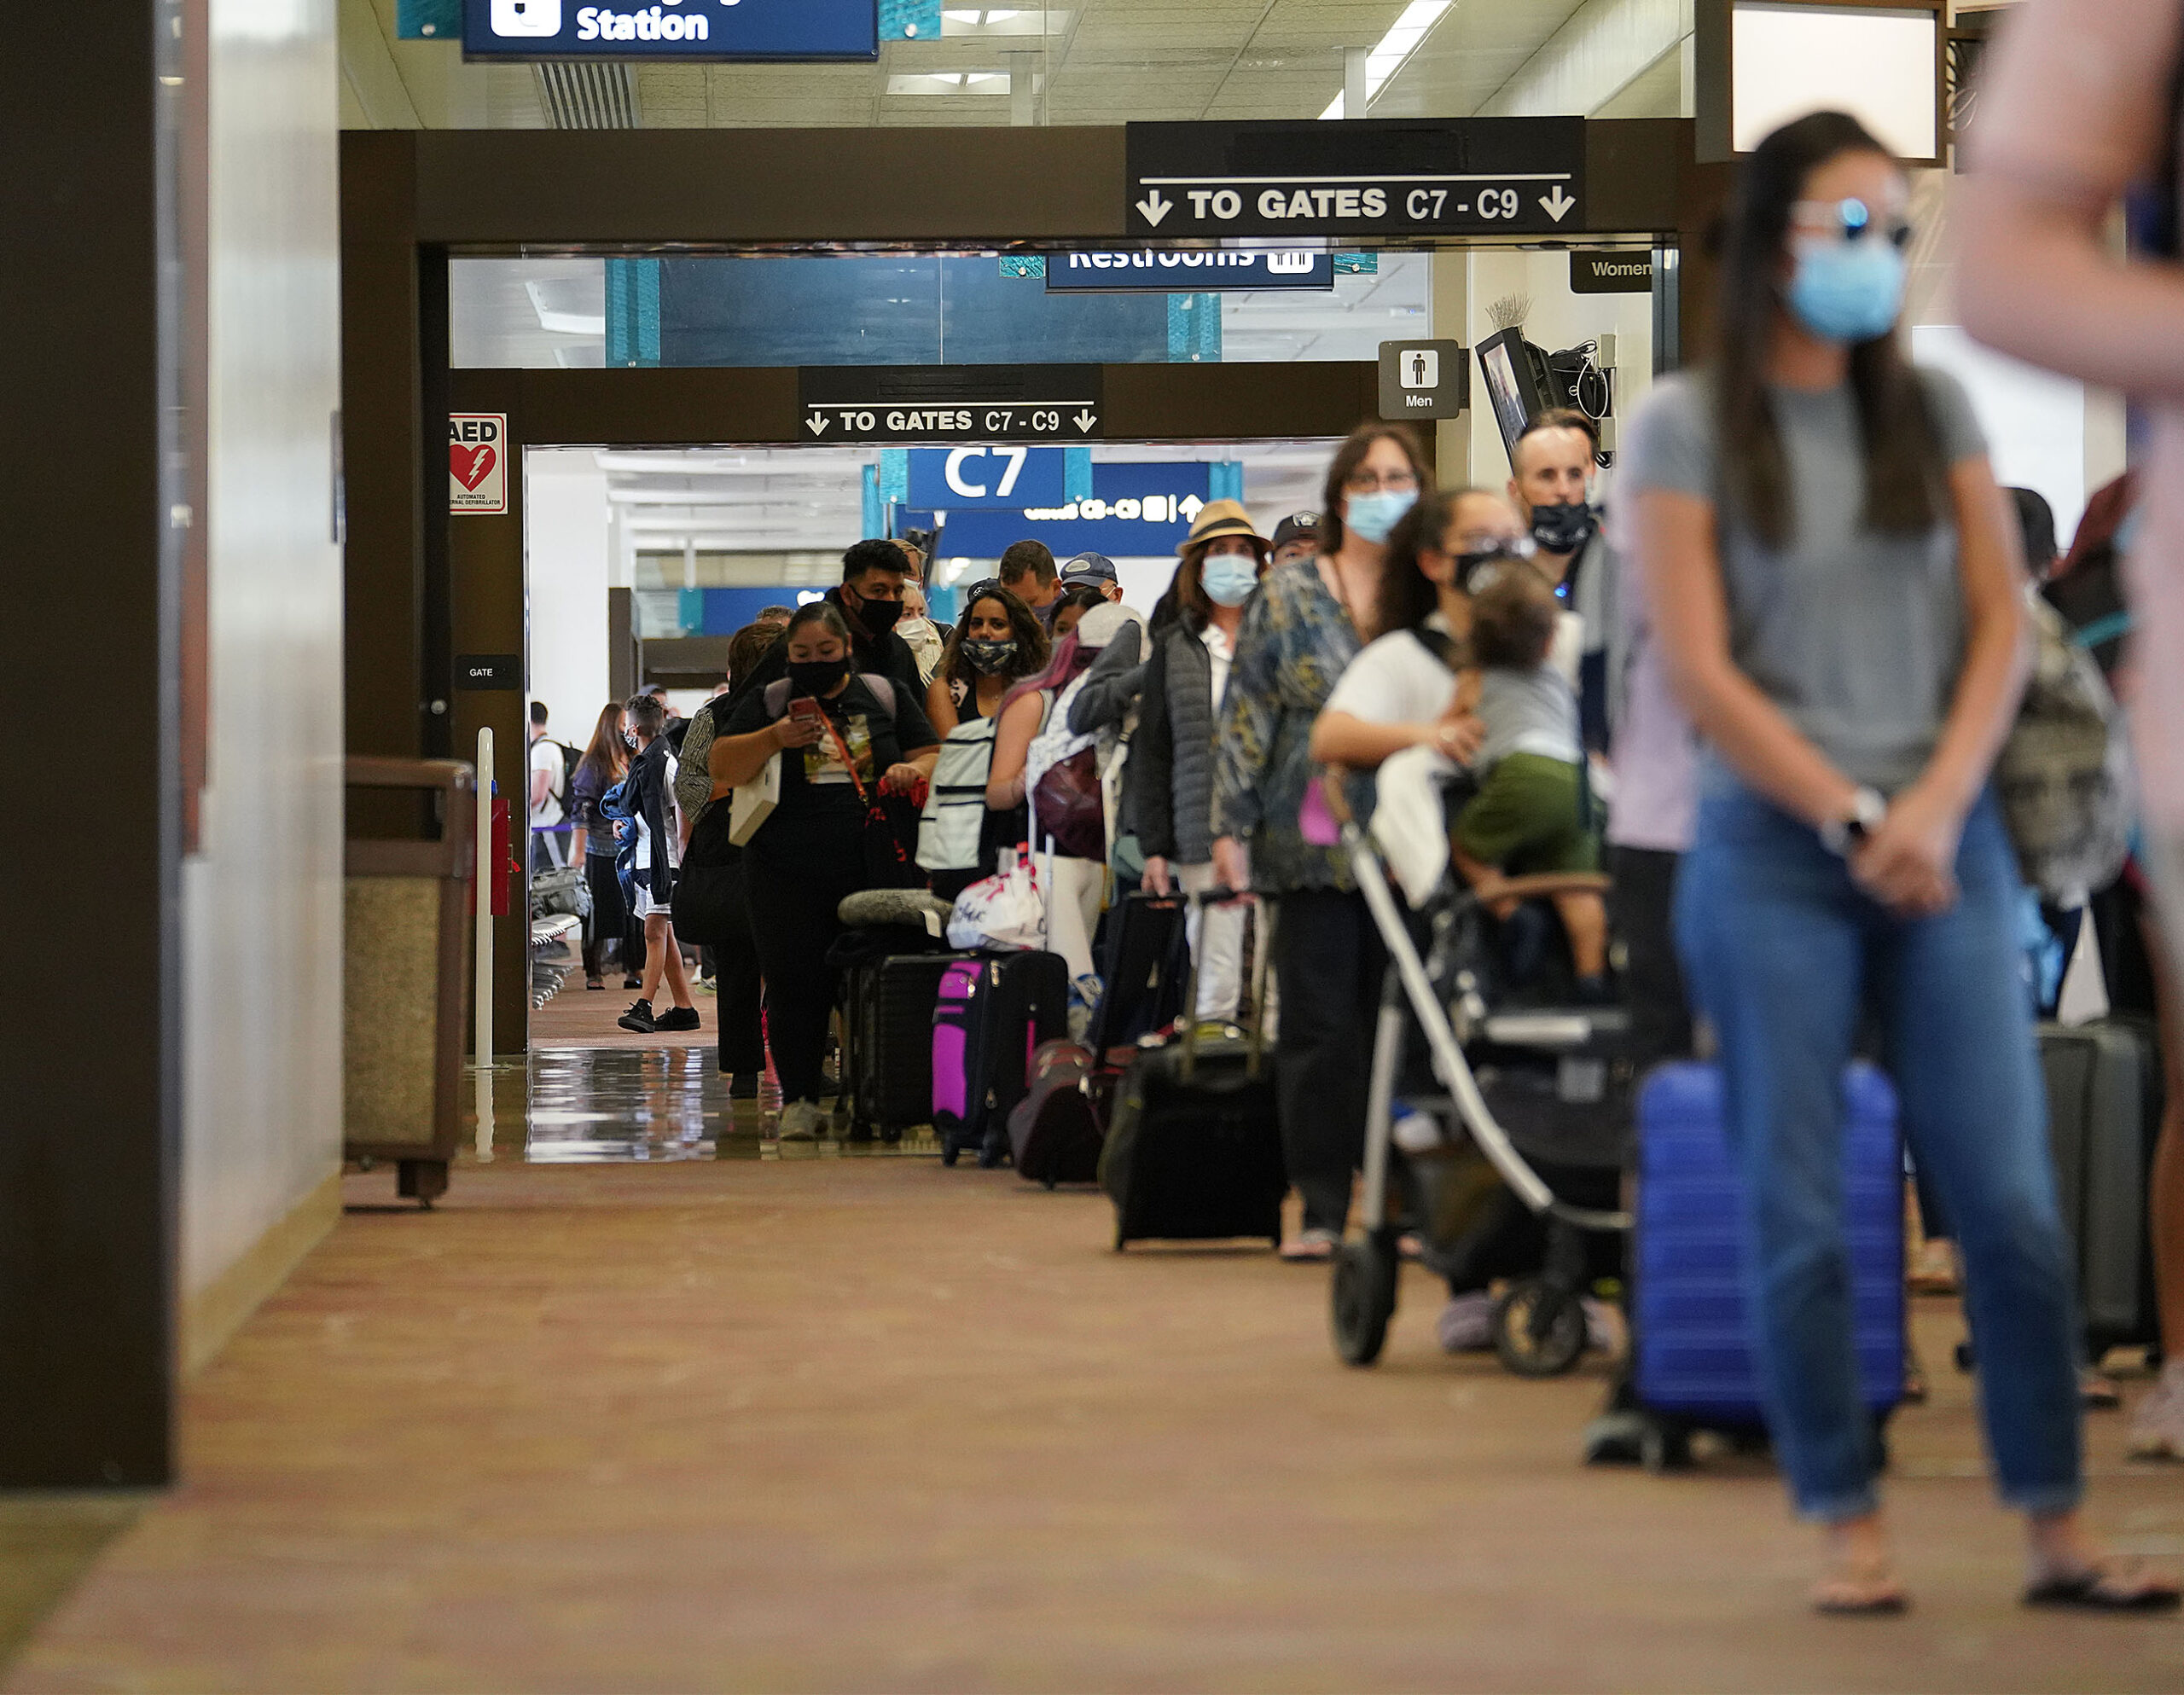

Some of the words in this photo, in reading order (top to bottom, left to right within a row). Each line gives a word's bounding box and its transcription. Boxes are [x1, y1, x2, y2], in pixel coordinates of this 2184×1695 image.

[576, 6, 709, 41] Station
[1187, 189, 1242, 219] TO
[1258, 189, 1387, 219] GATES
[1406, 189, 1448, 220] C7
[1477, 189, 1519, 219] C9
[1591, 261, 1653, 276] Women
[1405, 395, 1432, 407] Men
[449, 421, 497, 442] AED
[839, 411, 876, 431] TO
[886, 411, 973, 431] GATES
[985, 410, 1013, 432] C7
[1031, 410, 1060, 432] C9
[944, 448, 1027, 497] C7
[469, 668, 493, 676] GATE
